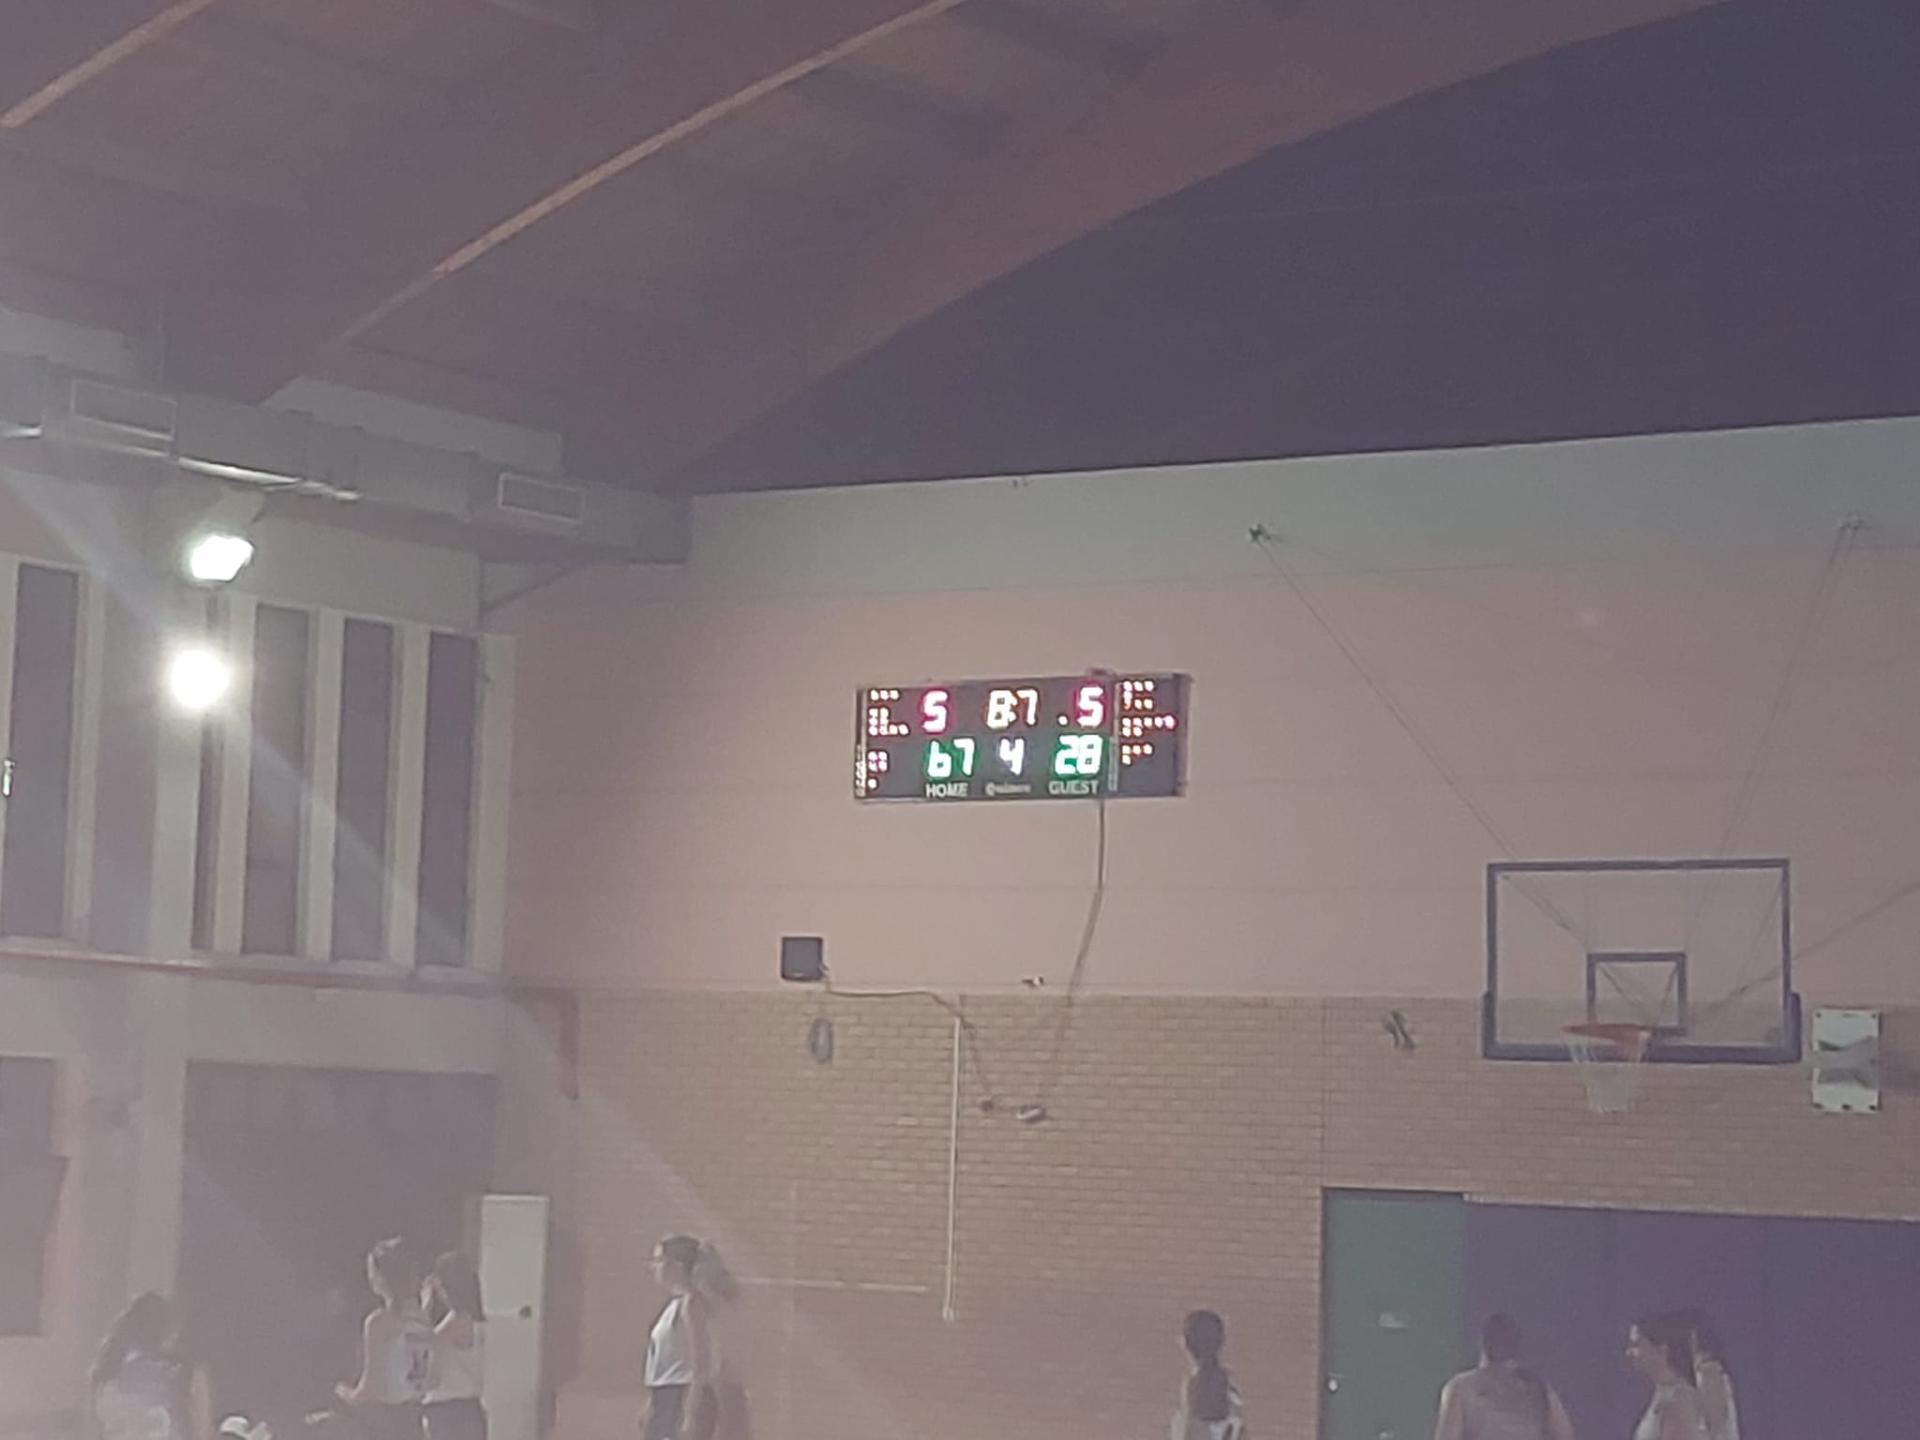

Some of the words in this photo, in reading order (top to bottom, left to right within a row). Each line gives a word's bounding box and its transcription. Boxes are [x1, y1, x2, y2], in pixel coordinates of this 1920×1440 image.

[999, 738, 1025, 775] 4
[1055, 734, 1103, 775] 28
[926, 782, 968, 798] HOME
[1048, 780, 1099, 794] GUEST
